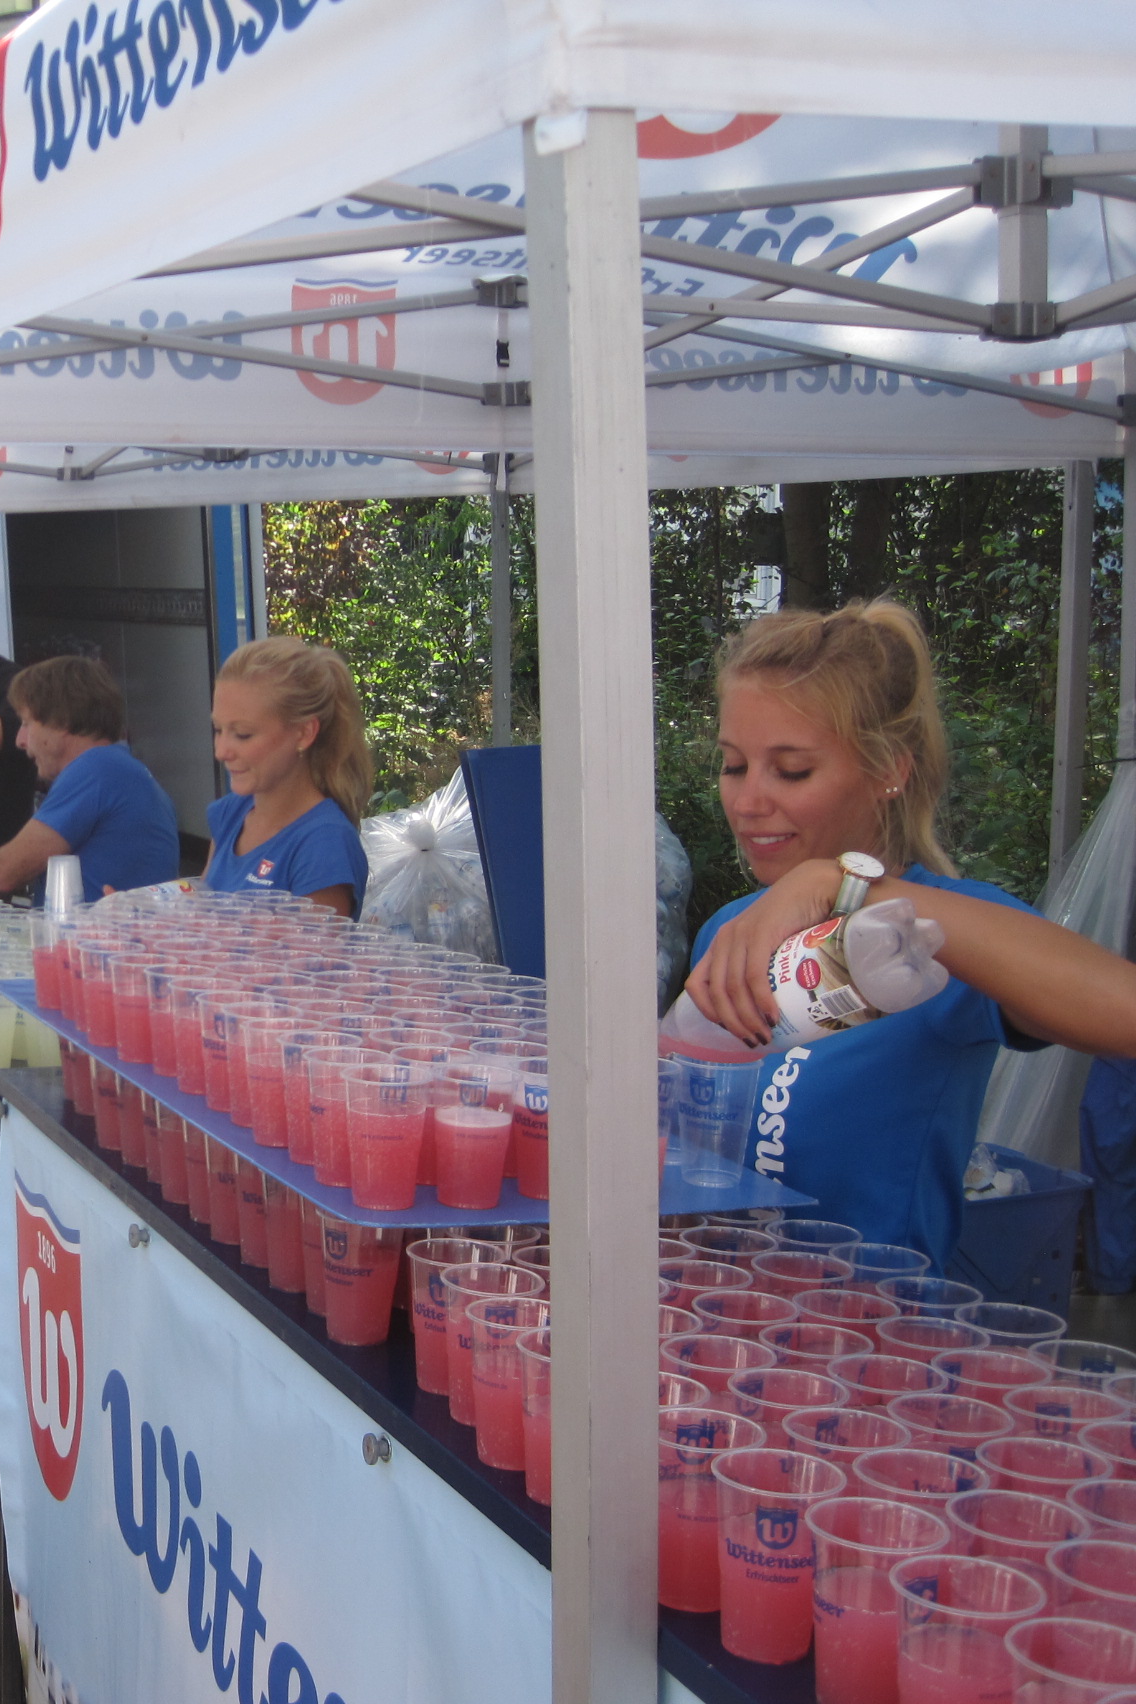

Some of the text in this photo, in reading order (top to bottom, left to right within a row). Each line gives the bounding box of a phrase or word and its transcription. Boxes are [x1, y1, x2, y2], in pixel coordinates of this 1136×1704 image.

[25, 0, 339, 182] Wittens
[778, 934, 798, 985] Pink Gra
[754, 1046, 812, 1182] nseer
[37, 1231, 57, 1274] 1896
[415, 1302, 446, 1321] Witte
[101, 1368, 348, 1704] Witte
[725, 1537, 817, 1570] Wittensee
